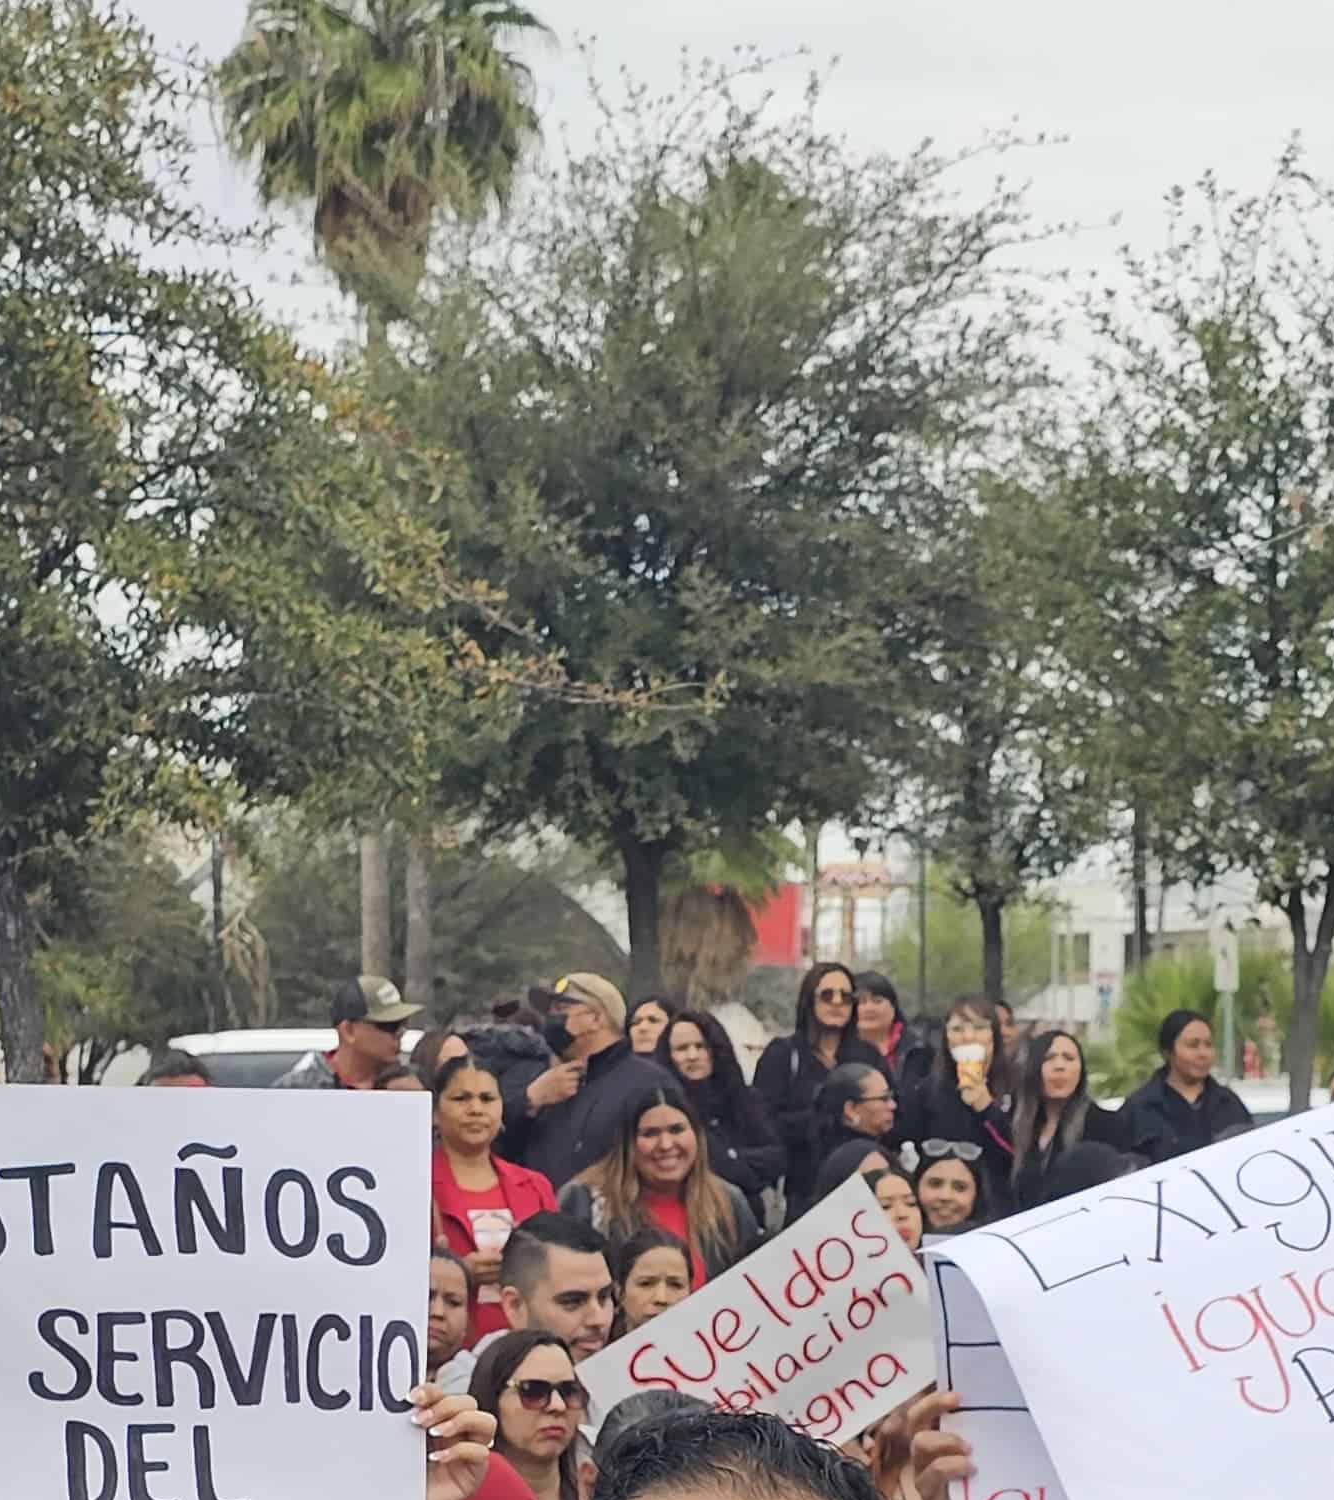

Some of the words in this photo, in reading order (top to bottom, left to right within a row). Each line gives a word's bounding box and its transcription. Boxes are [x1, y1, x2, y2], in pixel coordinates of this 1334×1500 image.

[28, 1309, 420, 1412] SERVICIO
[713, 1272, 913, 1414] bilación
[788, 1353, 908, 1437] igna
